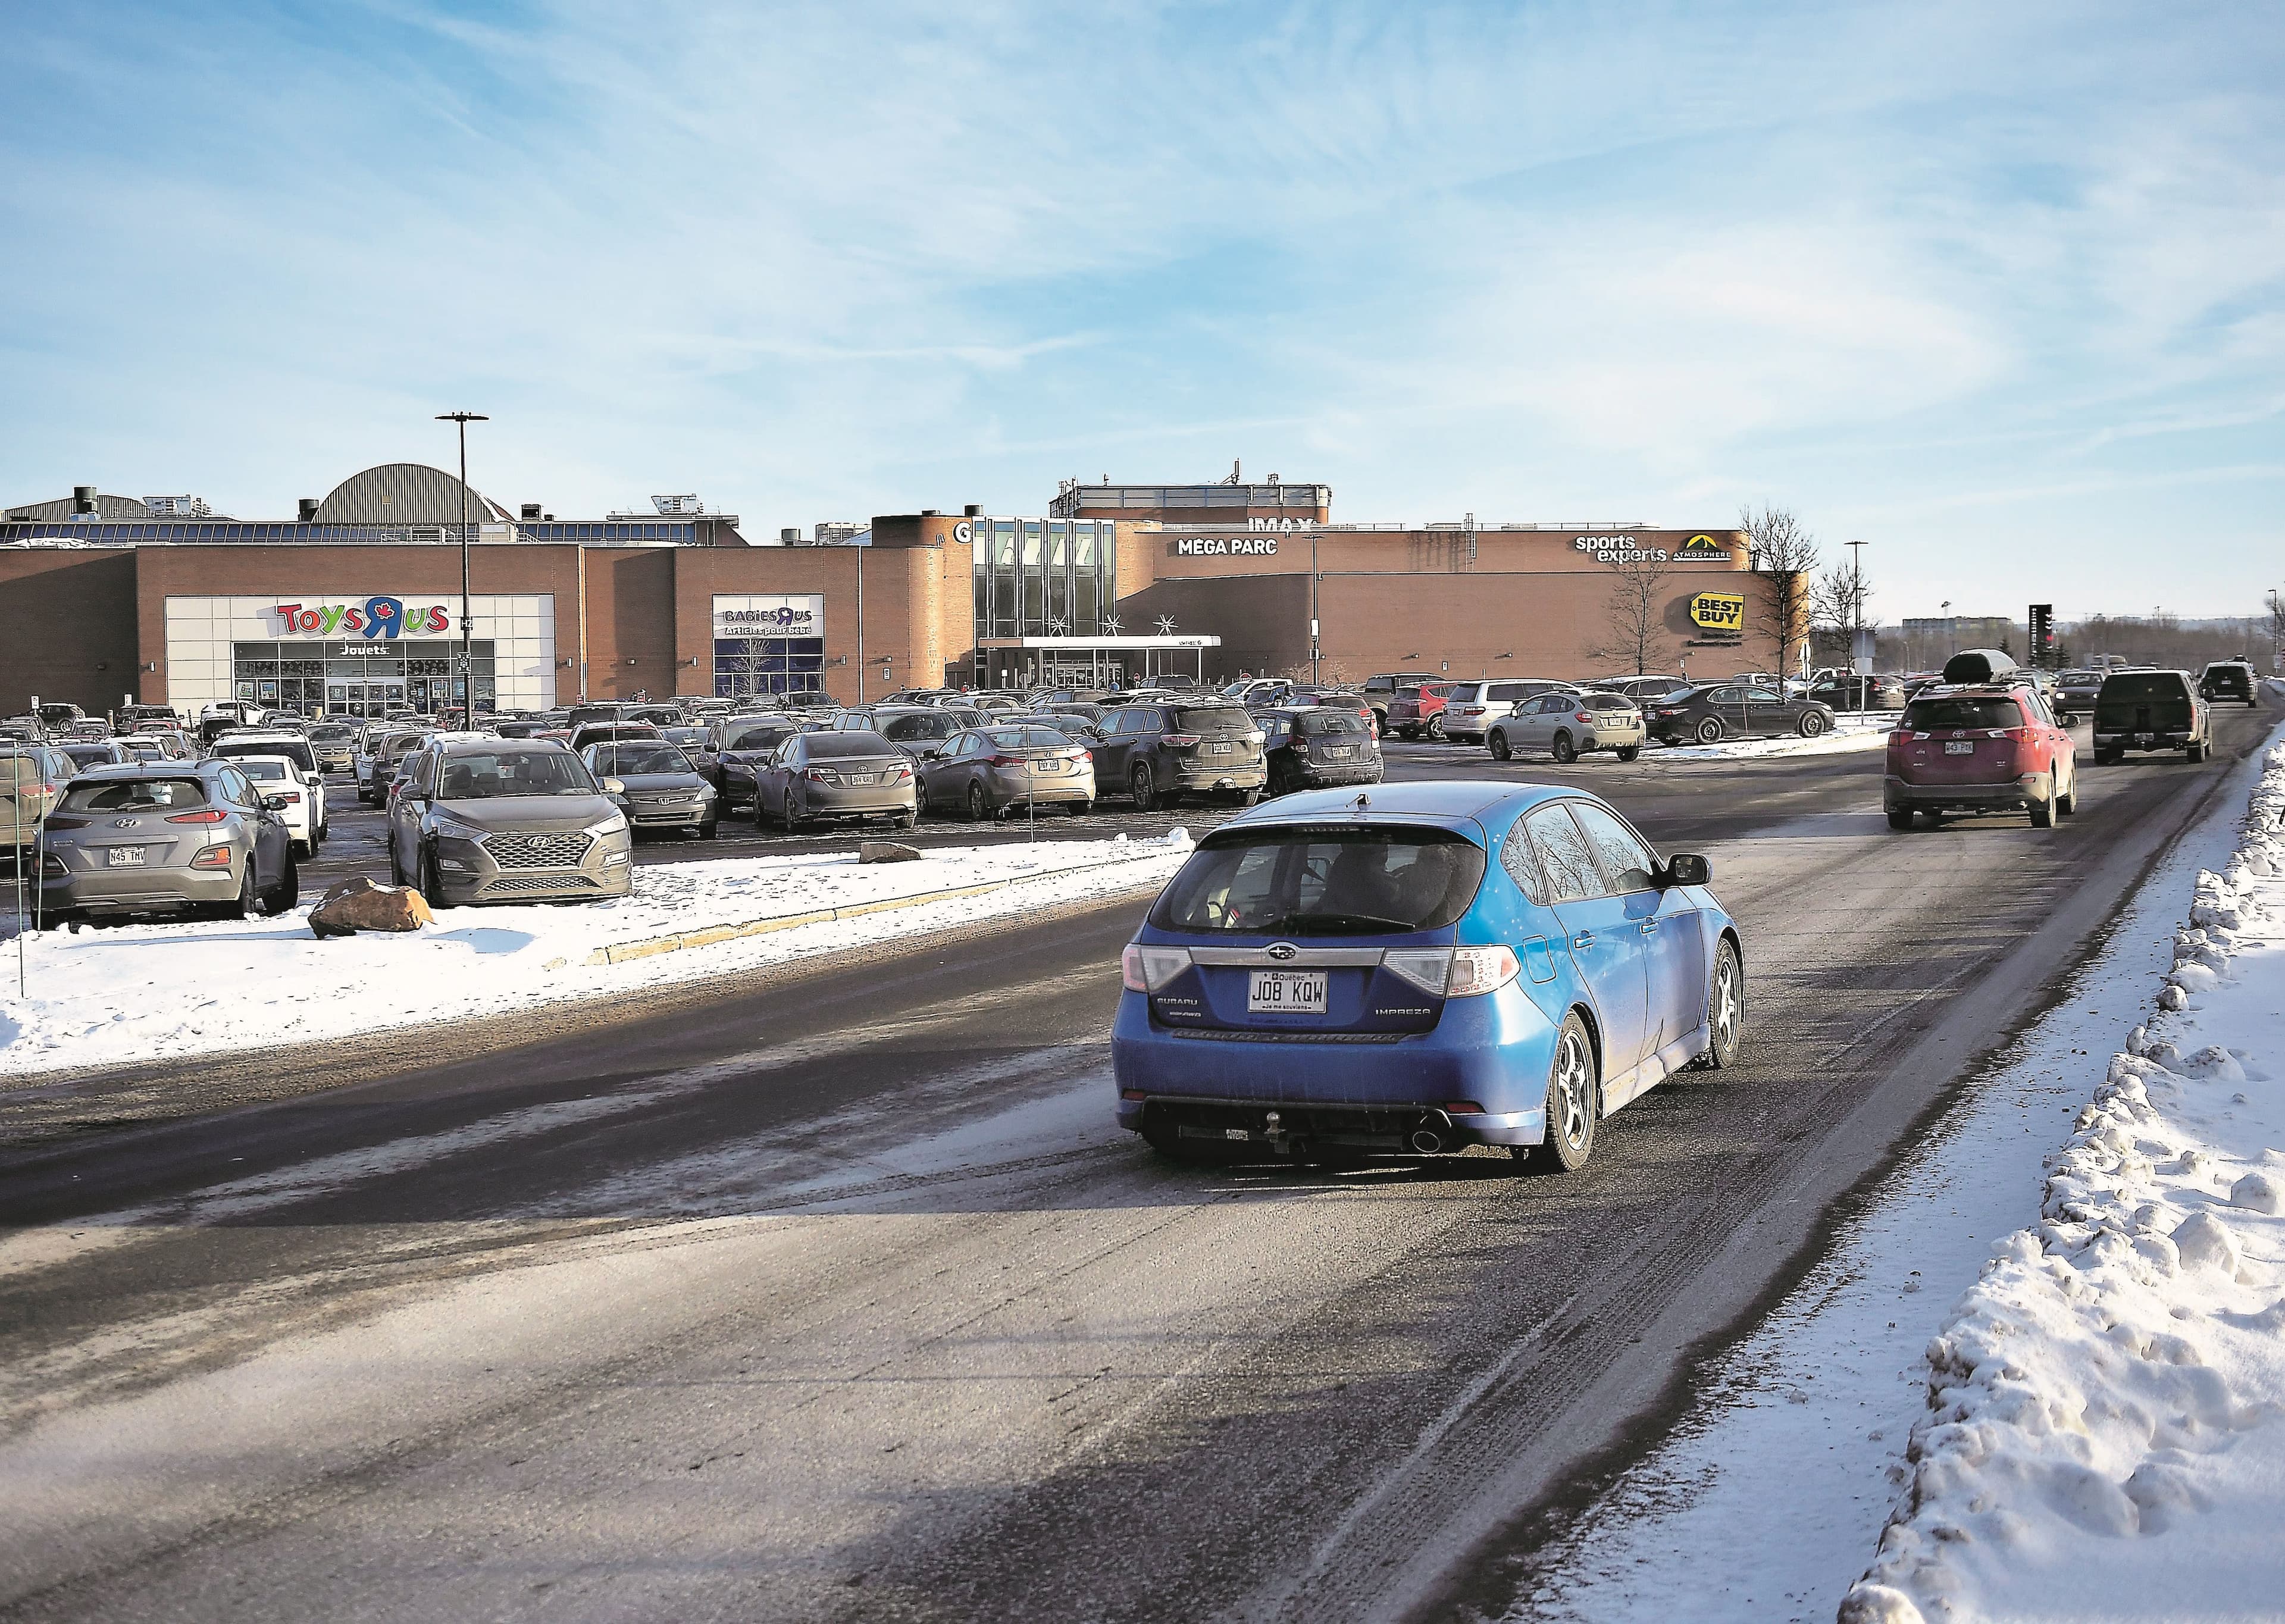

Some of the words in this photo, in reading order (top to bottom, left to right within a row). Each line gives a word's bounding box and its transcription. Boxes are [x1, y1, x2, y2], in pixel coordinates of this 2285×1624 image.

[953, 521, 972, 543] G
[1248, 517, 1313, 532] IMAX
[1178, 538, 1228, 555] MÉGA
[1230, 539, 1278, 555] PARC
[1575, 535, 1636, 553] sports
[1597, 547, 1667, 564] experts
[1698, 599, 1743, 613] BEST
[1699, 611, 1738, 624] BUY
[765, 627, 786, 636] pour
[341, 644, 387, 655] Jouets
[1292, 981, 1323, 1002] KQW
[1157, 997, 1198, 1006] SUBARU
